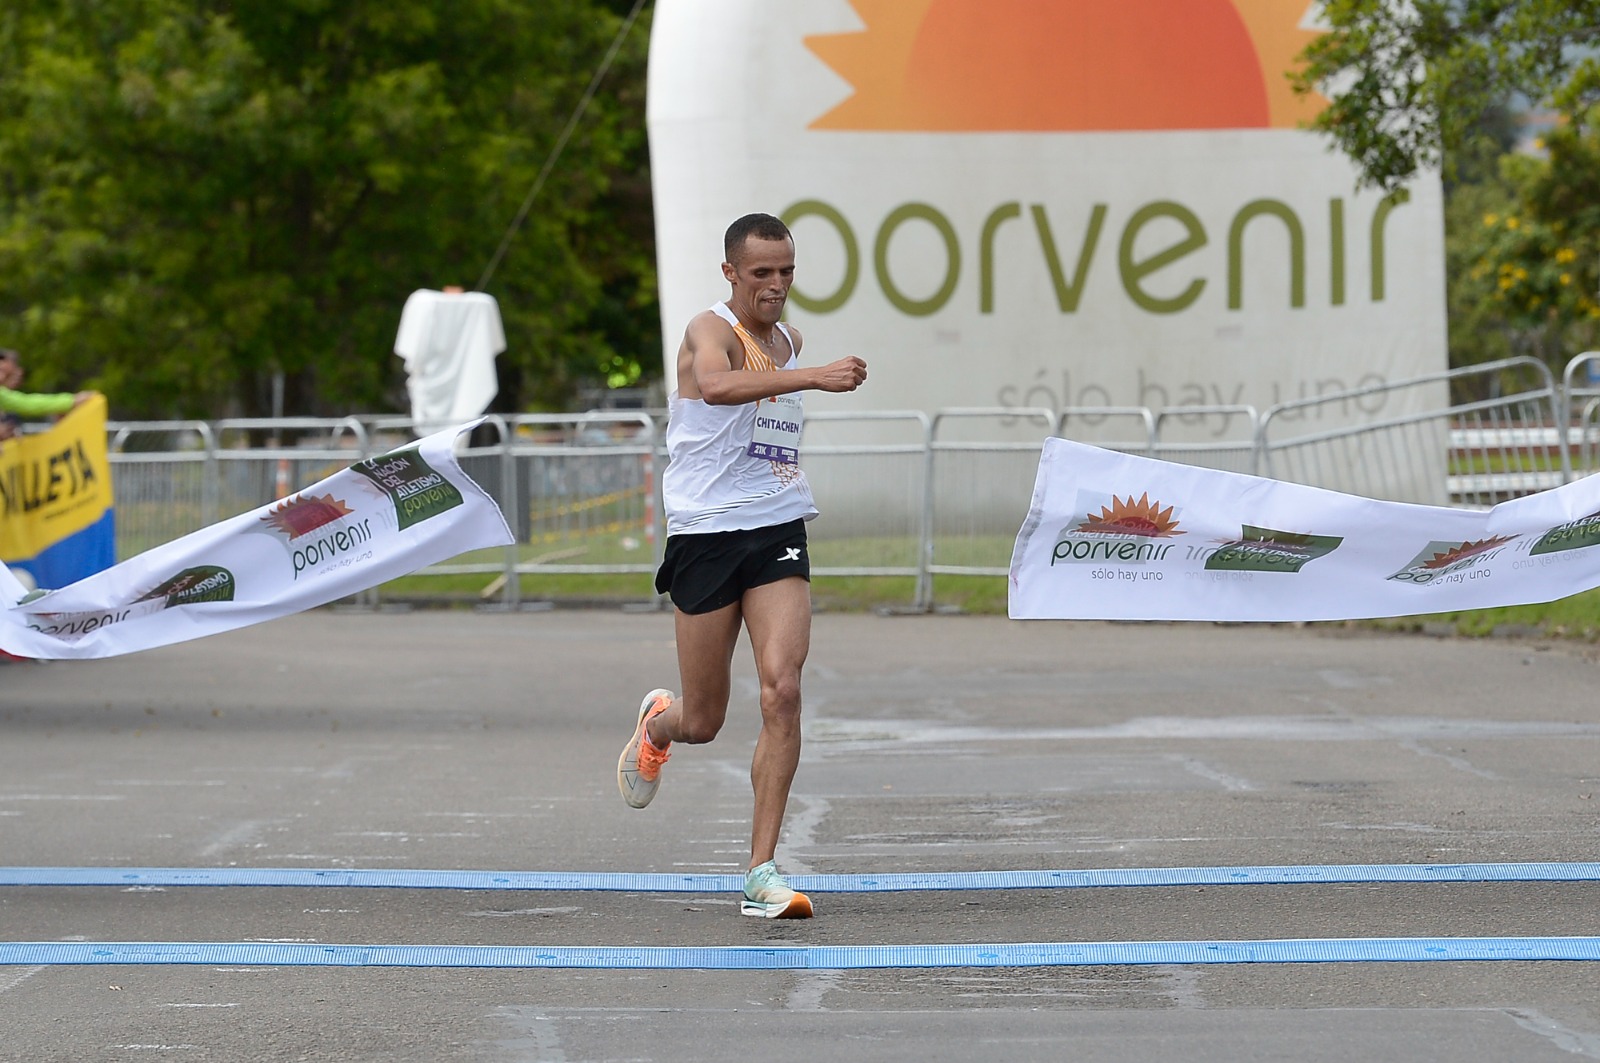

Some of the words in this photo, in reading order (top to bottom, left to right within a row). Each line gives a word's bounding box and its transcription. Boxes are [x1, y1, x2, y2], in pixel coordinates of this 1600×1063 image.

[780, 187, 1410, 322] porvenir
[996, 368, 1113, 428] sólo
[1137, 366, 1244, 437] hay
[1271, 373, 1393, 423] uno
[756, 417, 800, 434] CHITACHEN
[753, 445, 768, 456] 21K
[372, 457, 412, 480] NACIÓN
[381, 475, 406, 489] DEL
[395, 472, 442, 499] ATLETISMO
[403, 484, 454, 519] porvenir
[292, 518, 372, 581] porvenir
[1051, 540, 1176, 567] porvenir
[1091, 568, 1115, 581] sólo
[1118, 569, 1138, 583] hay
[1141, 570, 1164, 581] uno
[1446, 571, 1466, 584] hay
[1469, 568, 1491, 581] uno
